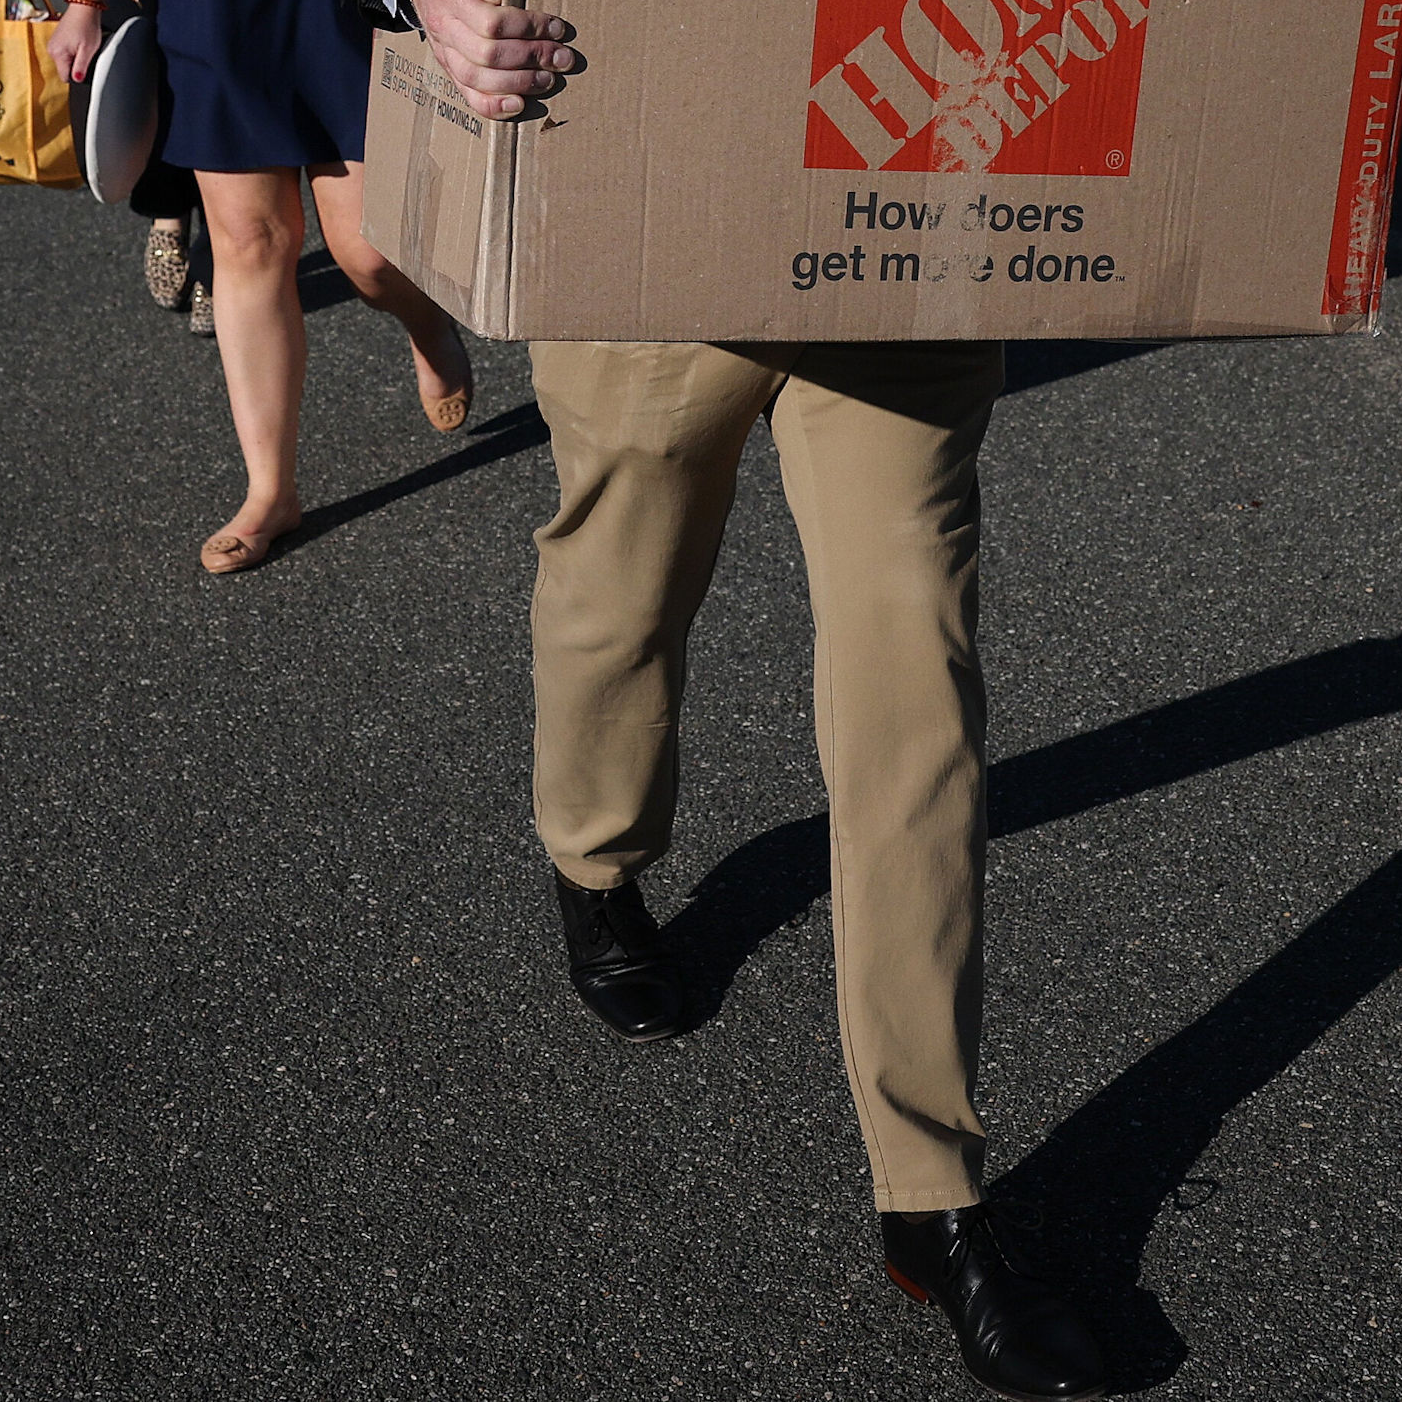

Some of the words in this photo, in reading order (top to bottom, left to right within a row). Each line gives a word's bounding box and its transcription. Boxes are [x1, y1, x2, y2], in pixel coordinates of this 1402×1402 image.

[844, 191, 947, 233] How
[959, 193, 1085, 234] doers
[791, 247, 867, 291] get
